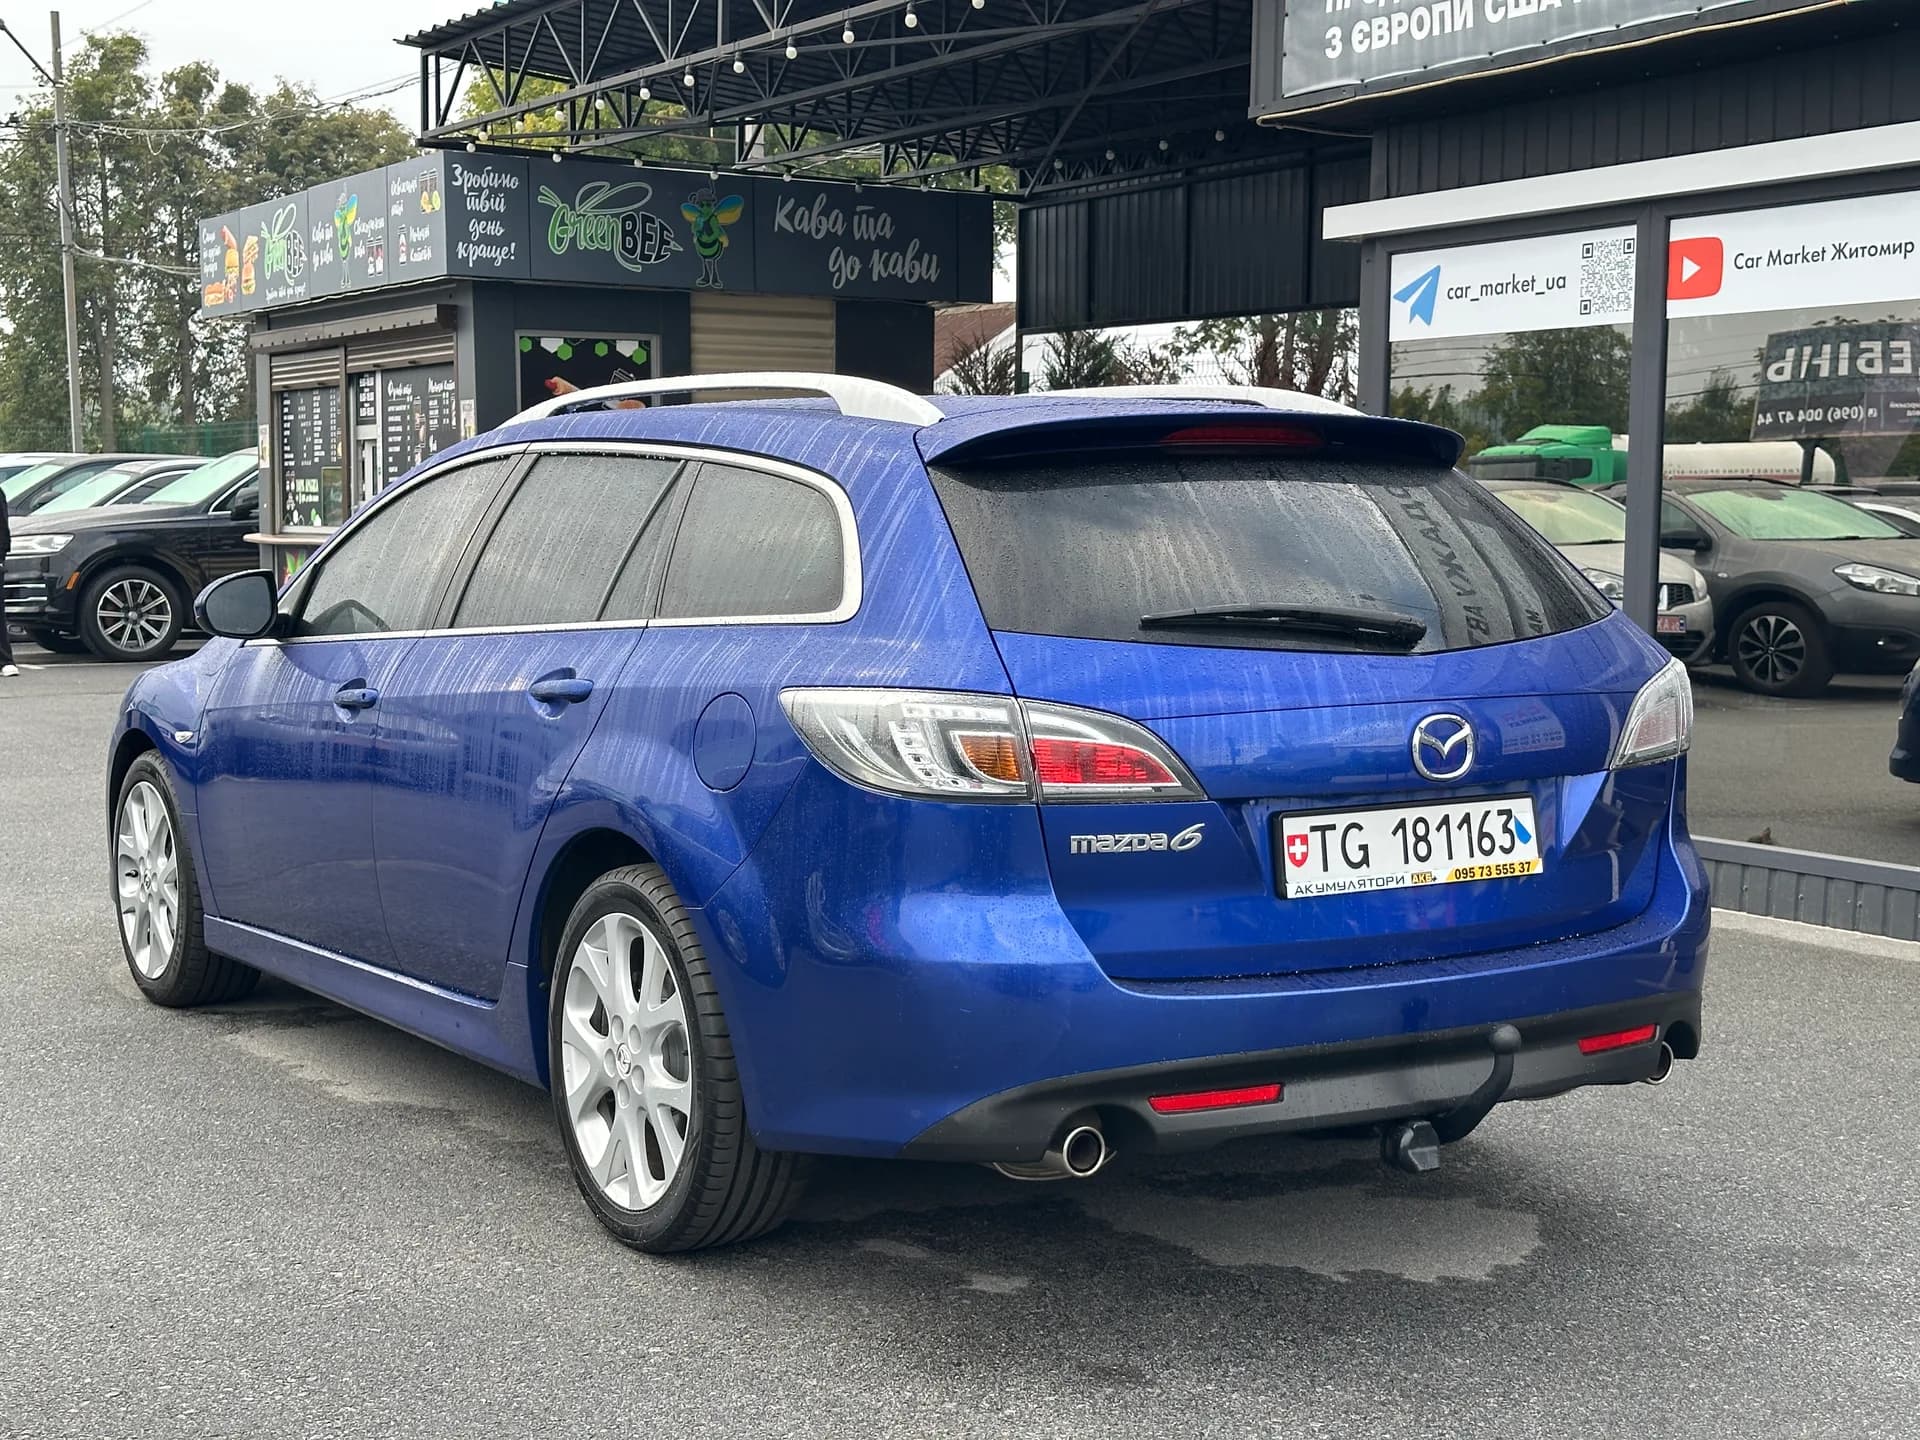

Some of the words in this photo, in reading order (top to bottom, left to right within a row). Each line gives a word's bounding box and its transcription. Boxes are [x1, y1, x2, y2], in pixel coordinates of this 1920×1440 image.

[1325, 26, 1343, 59] З
[1351, 0, 1474, 54] ЄВРОПИ
[451, 163, 519, 195] Зробимо
[466, 188, 506, 213] твій
[469, 217, 504, 241] день
[774, 193, 847, 240] Кава
[853, 204, 895, 241] та
[456, 241, 516, 268] краще!
[828, 246, 861, 290] до
[869, 238, 940, 284] кави
[1734, 253, 1762, 270] Car
[1767, 245, 1826, 267] Market
[1831, 241, 1915, 260] Житомир
[1447, 273, 1567, 302] car_market_ua
[1309, 822, 1370, 873] TG
[1391, 808, 1516, 865] 181163
[1294, 876, 1405, 896] АКУМУЛЯТОРИ
[1454, 867, 1475, 880] 095
[1479, 865, 1492, 878] 73
[1495, 863, 1516, 876] 555
[1518, 861, 1531, 873] 37
